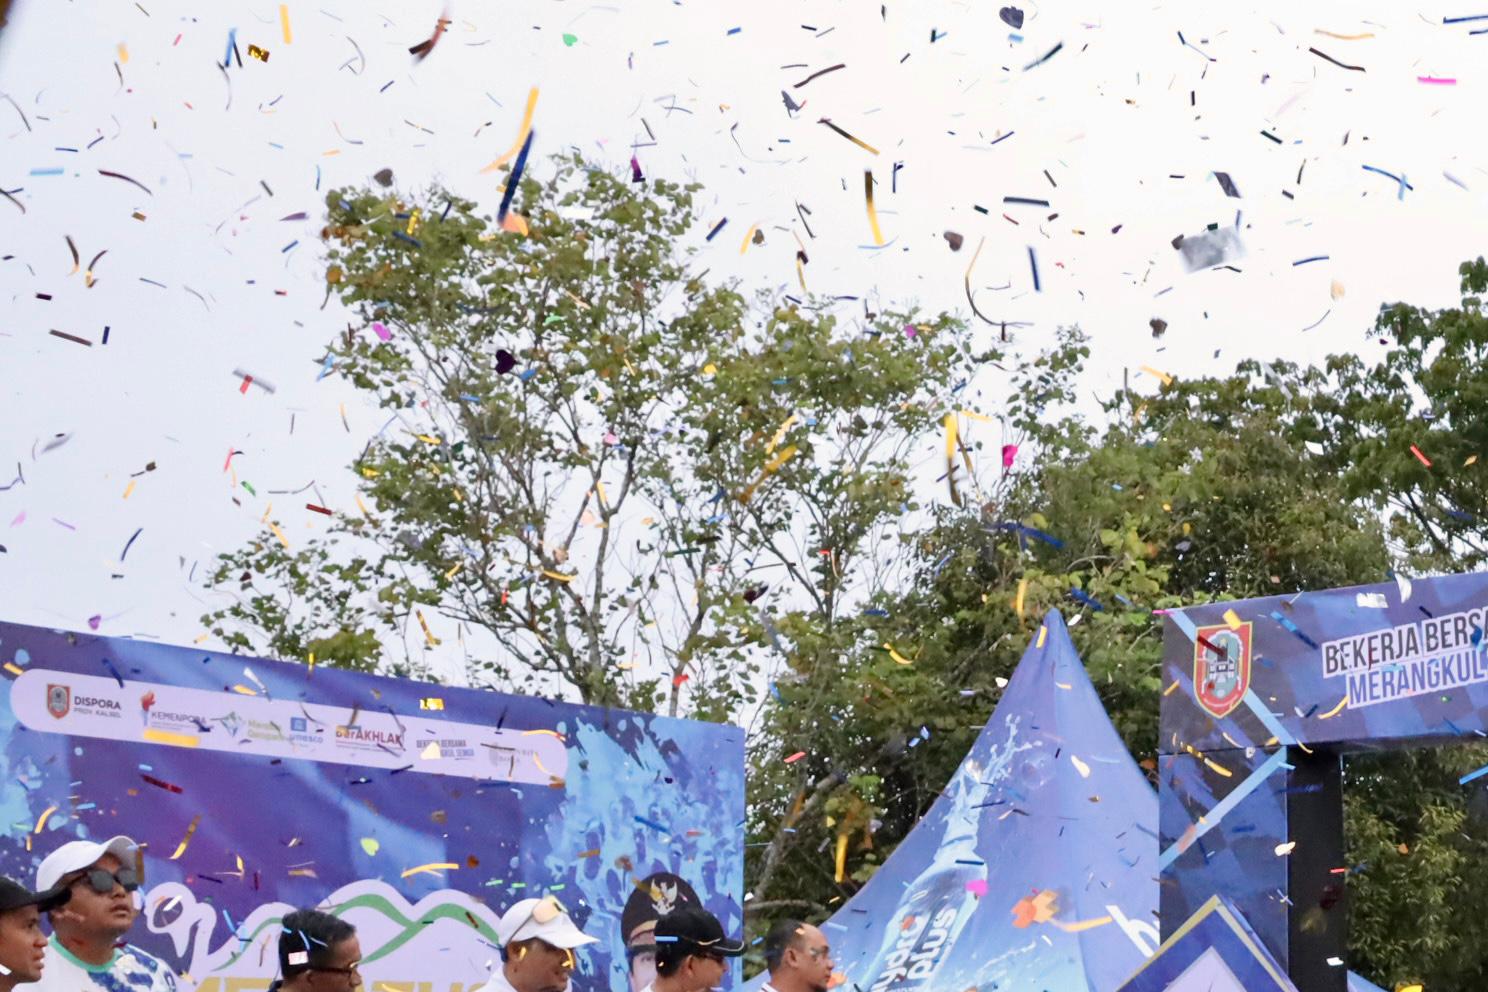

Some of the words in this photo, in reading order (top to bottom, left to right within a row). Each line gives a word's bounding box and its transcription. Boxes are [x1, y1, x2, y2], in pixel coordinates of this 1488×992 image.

[1325, 627, 1420, 674] BEKERJA
[1350, 643, 1484, 704] MERANGKUL
[74, 696, 121, 710] DISPORA
